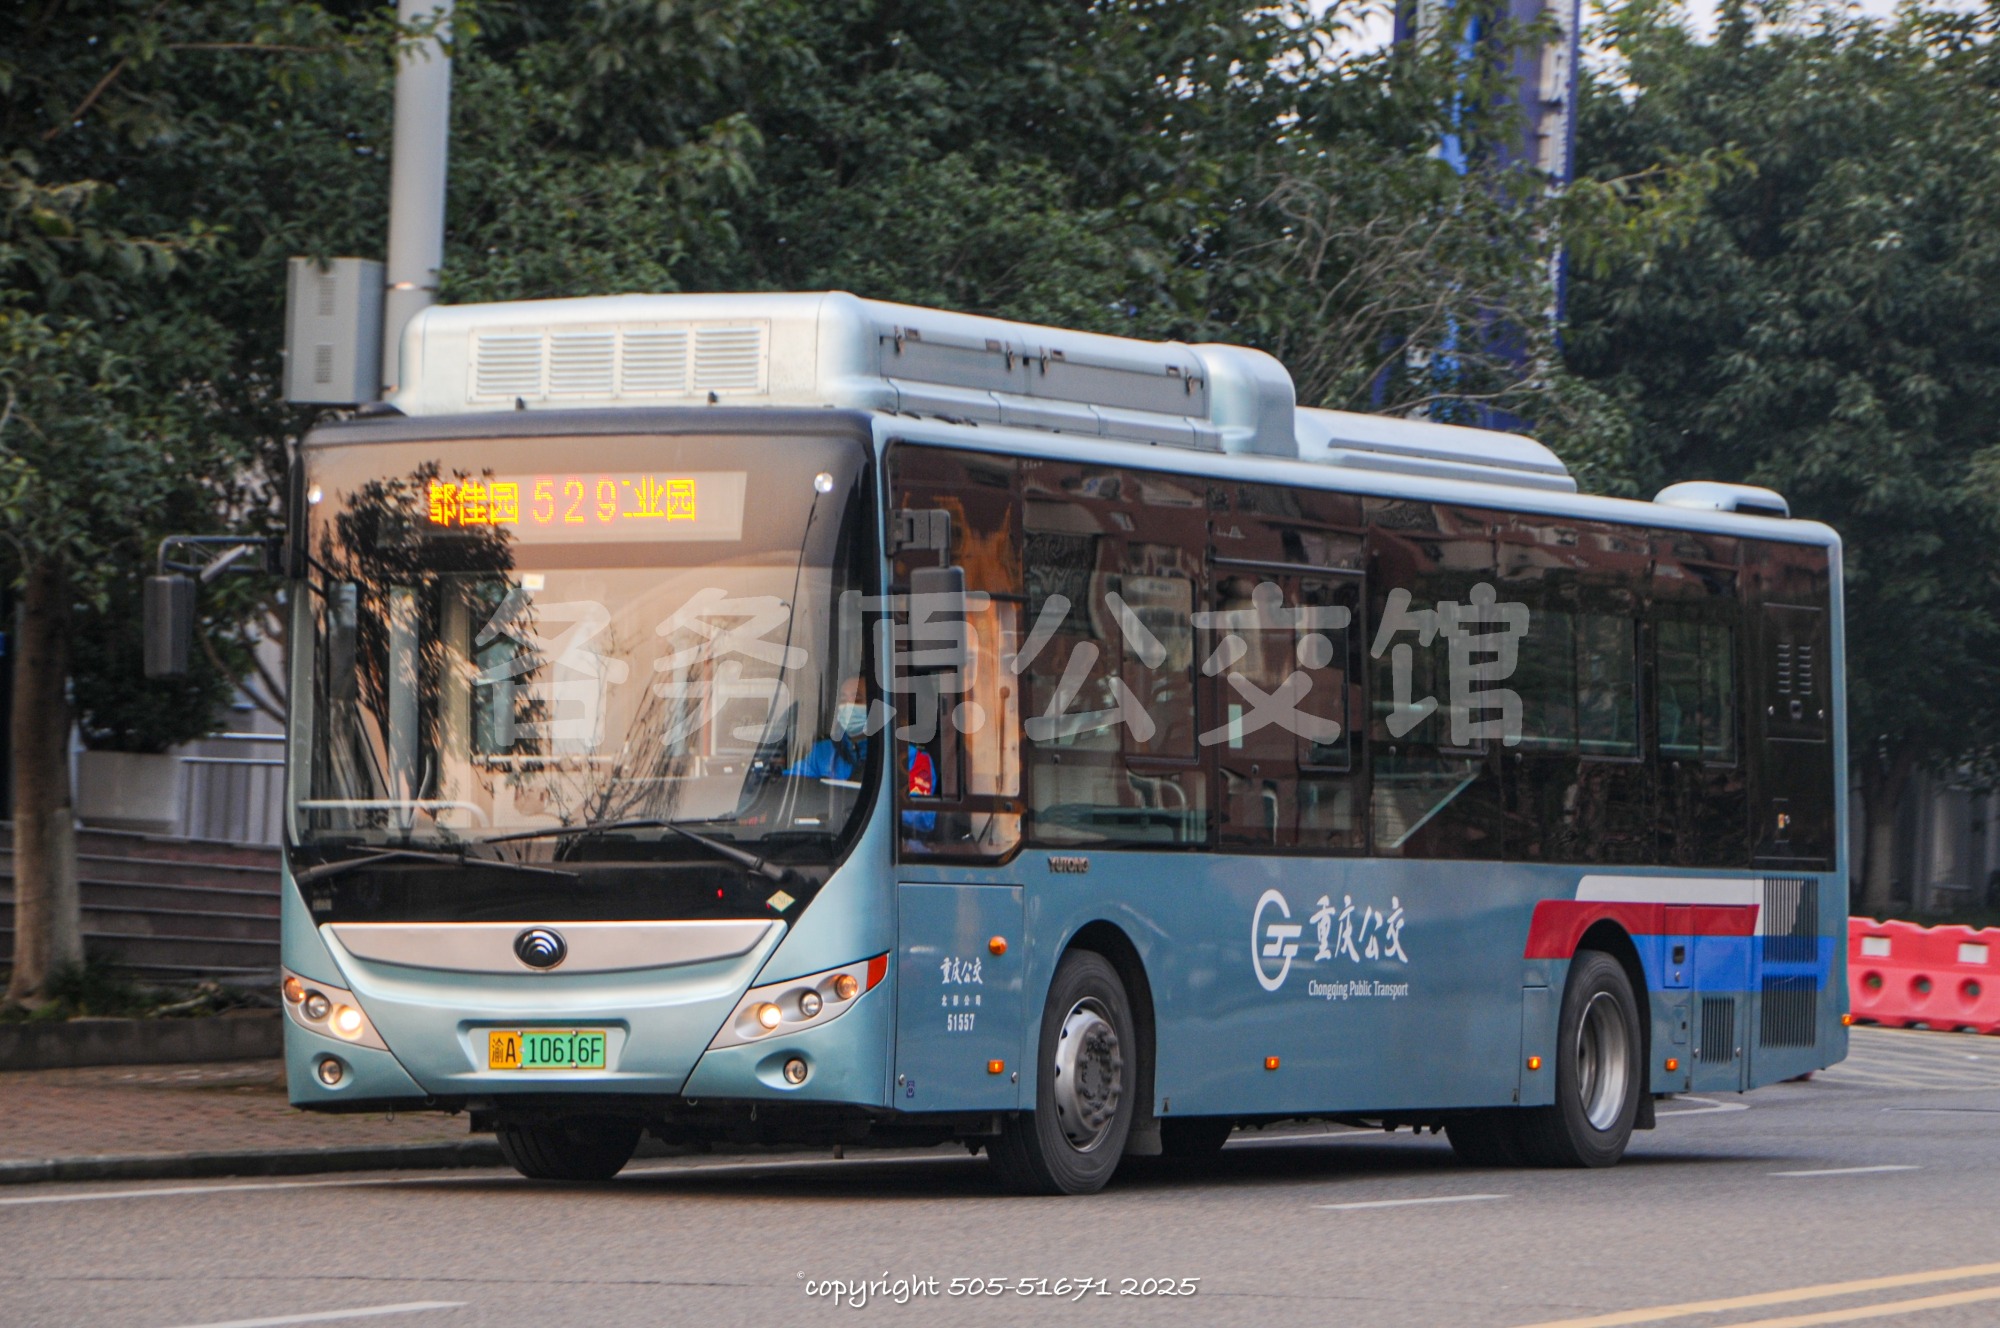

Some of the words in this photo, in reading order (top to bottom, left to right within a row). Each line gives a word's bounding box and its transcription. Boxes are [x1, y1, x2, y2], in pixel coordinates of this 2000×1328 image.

[532, 477, 617, 524] 529
[1047, 856, 1090, 873] YUTONG
[1309, 894, 1409, 964] 重庆公交
[940, 956, 984, 985] 重庆公交
[1308, 980, 1348, 1000] Chongqing
[1349, 980, 1372, 996] Public
[1374, 980, 1409, 1000] Transport
[947, 1013, 975, 1031] 51557
[491, 1036, 517, 1063] 渝A
[529, 1037, 602, 1063] 10616F
